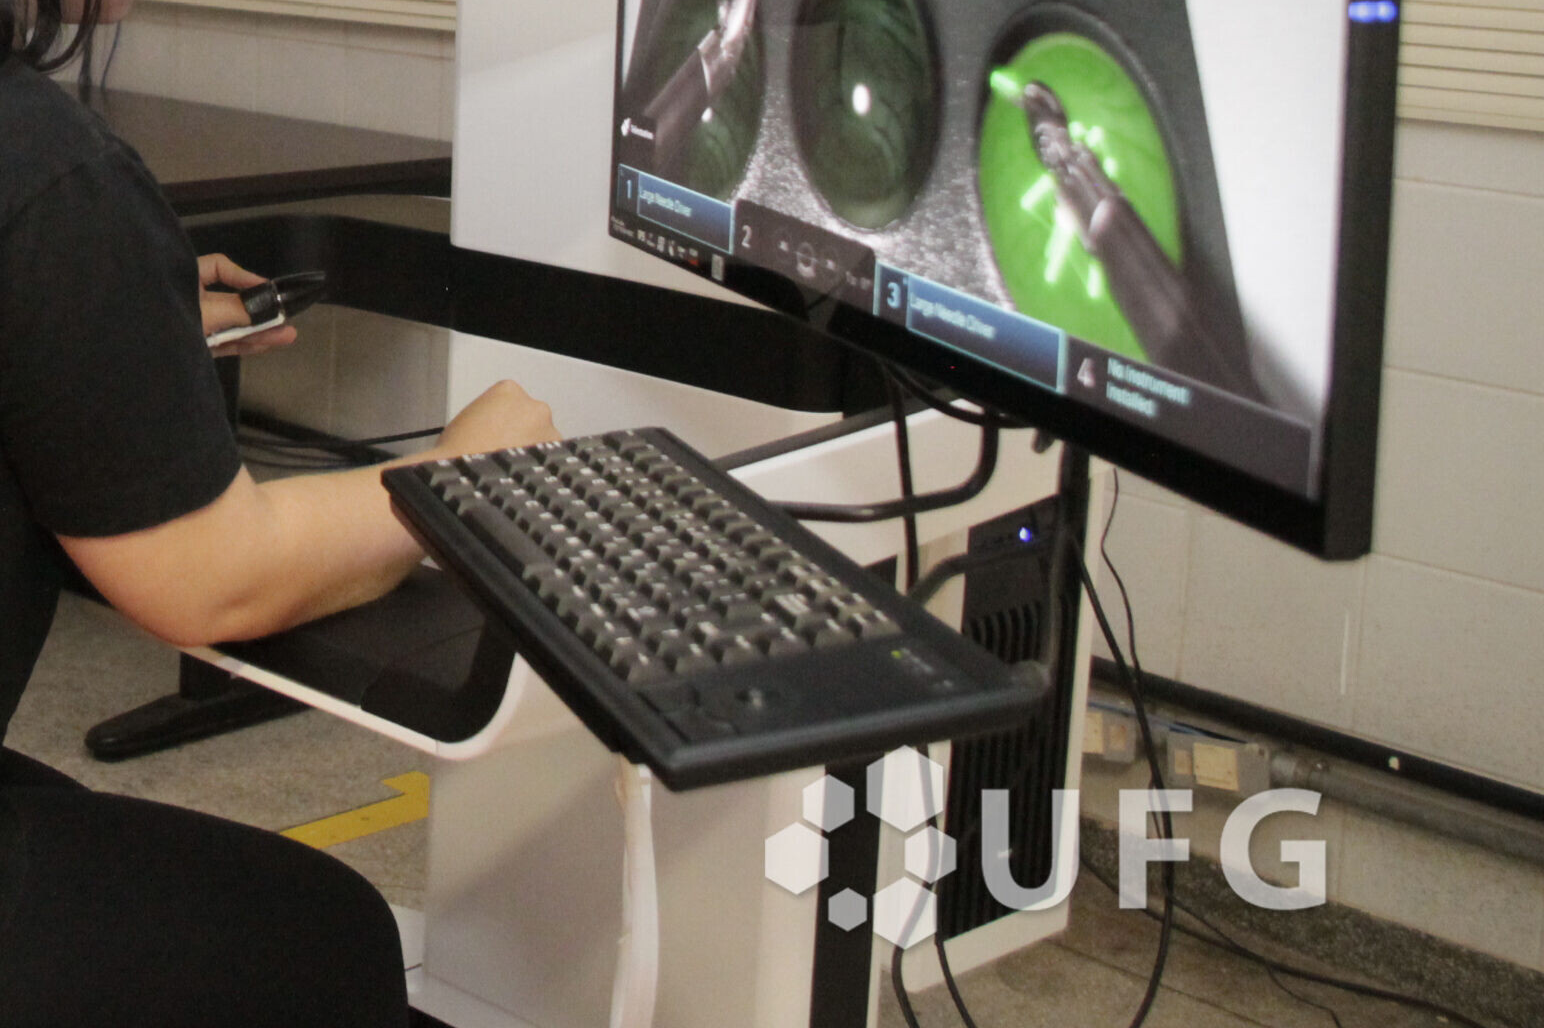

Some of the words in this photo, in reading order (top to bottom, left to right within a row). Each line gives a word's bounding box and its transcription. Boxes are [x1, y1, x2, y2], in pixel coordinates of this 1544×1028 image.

[626, 180, 633, 199] 1
[741, 224, 753, 248] 2
[886, 282, 902, 309] 3
[1076, 357, 1096, 388] 4
